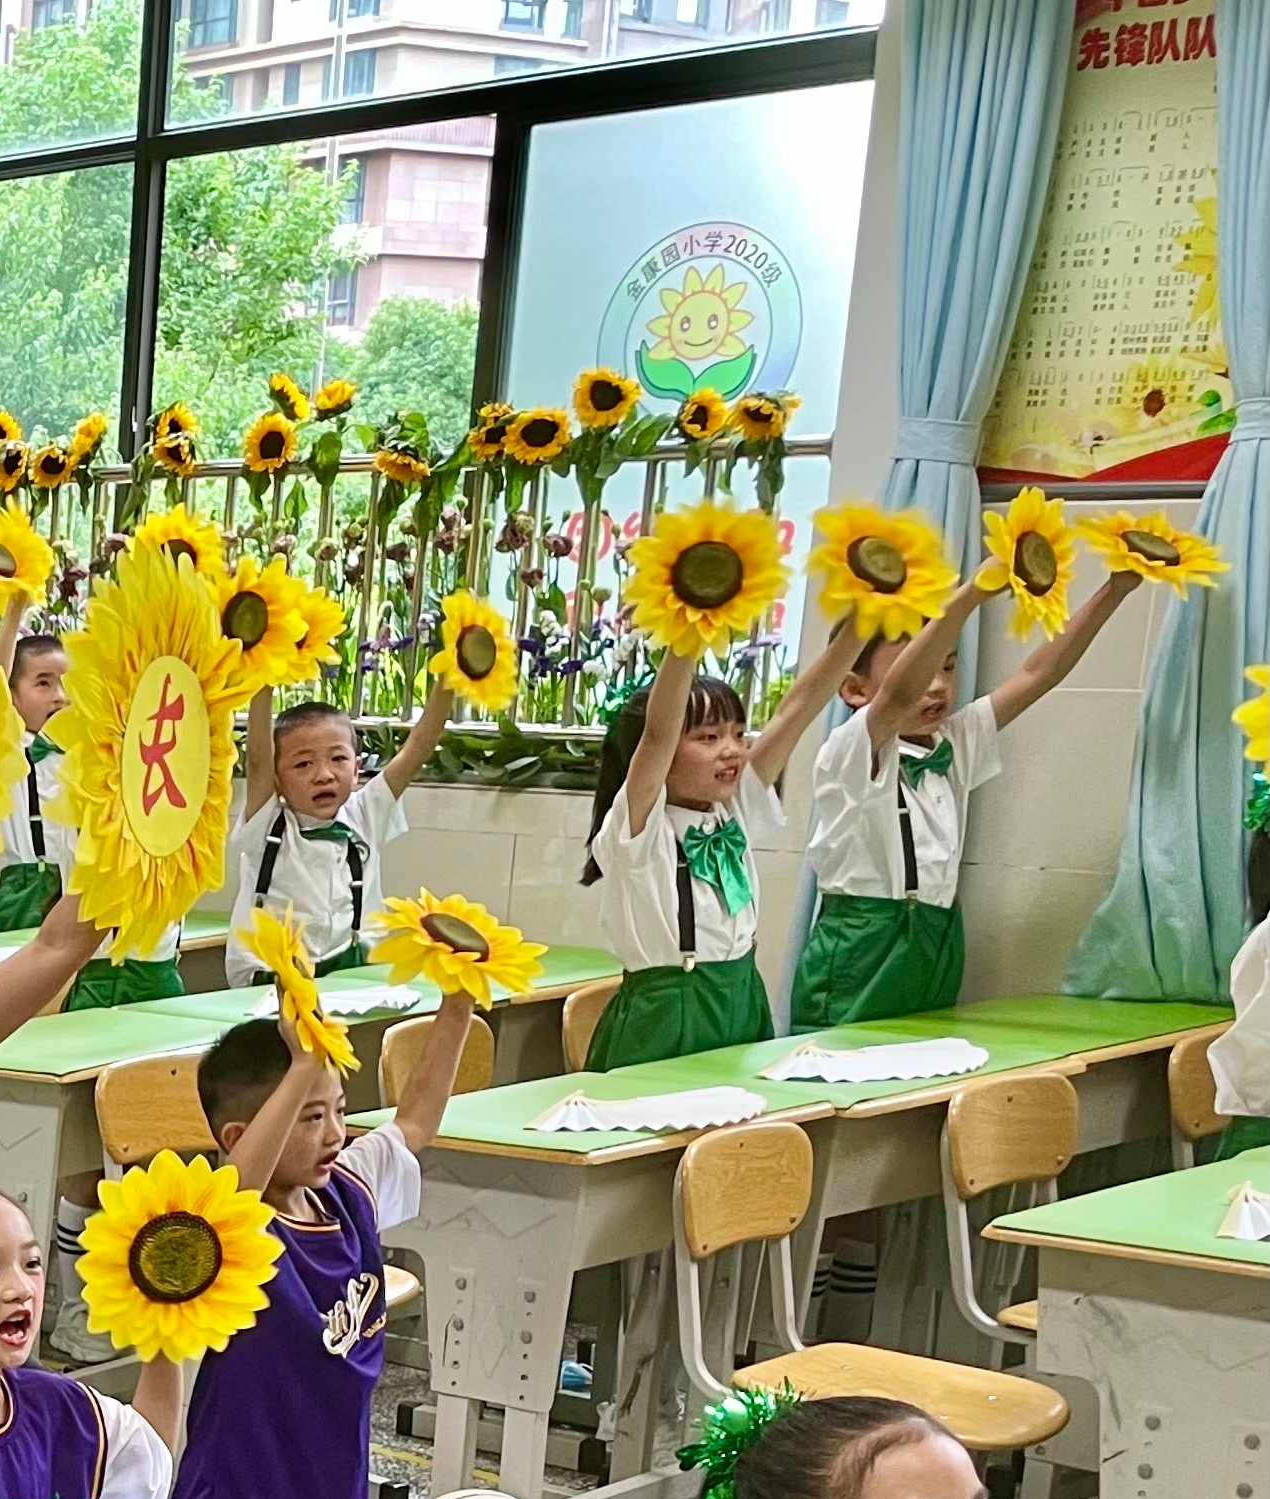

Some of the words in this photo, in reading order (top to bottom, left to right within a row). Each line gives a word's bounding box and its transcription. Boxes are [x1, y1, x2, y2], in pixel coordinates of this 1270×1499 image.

[626, 231, 784, 302] 金康园小学2020级
[138, 673, 187, 817] 长
